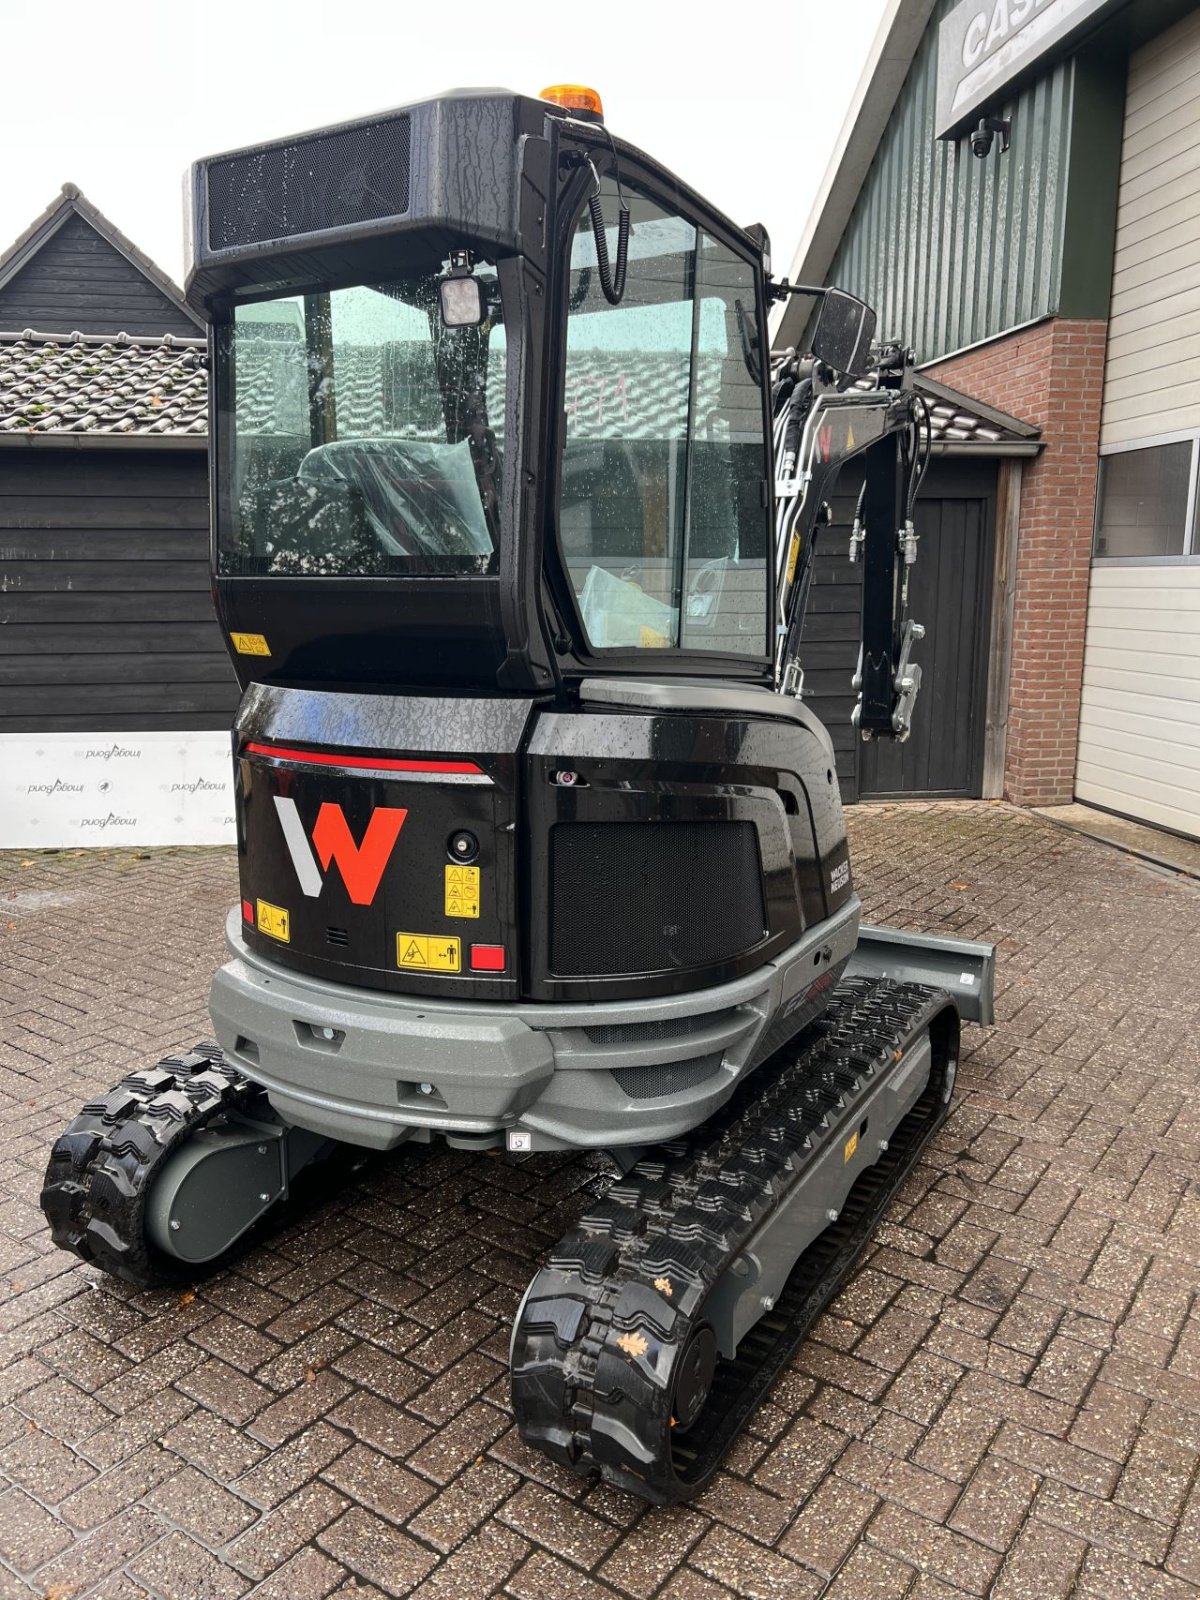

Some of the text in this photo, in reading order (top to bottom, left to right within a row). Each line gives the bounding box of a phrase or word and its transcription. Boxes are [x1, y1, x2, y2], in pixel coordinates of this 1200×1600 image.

[962, 0, 1044, 68] CAS
[273, 795, 408, 906] W
[830, 860, 849, 881] WACKER
[830, 871, 850, 894] NEUSON
